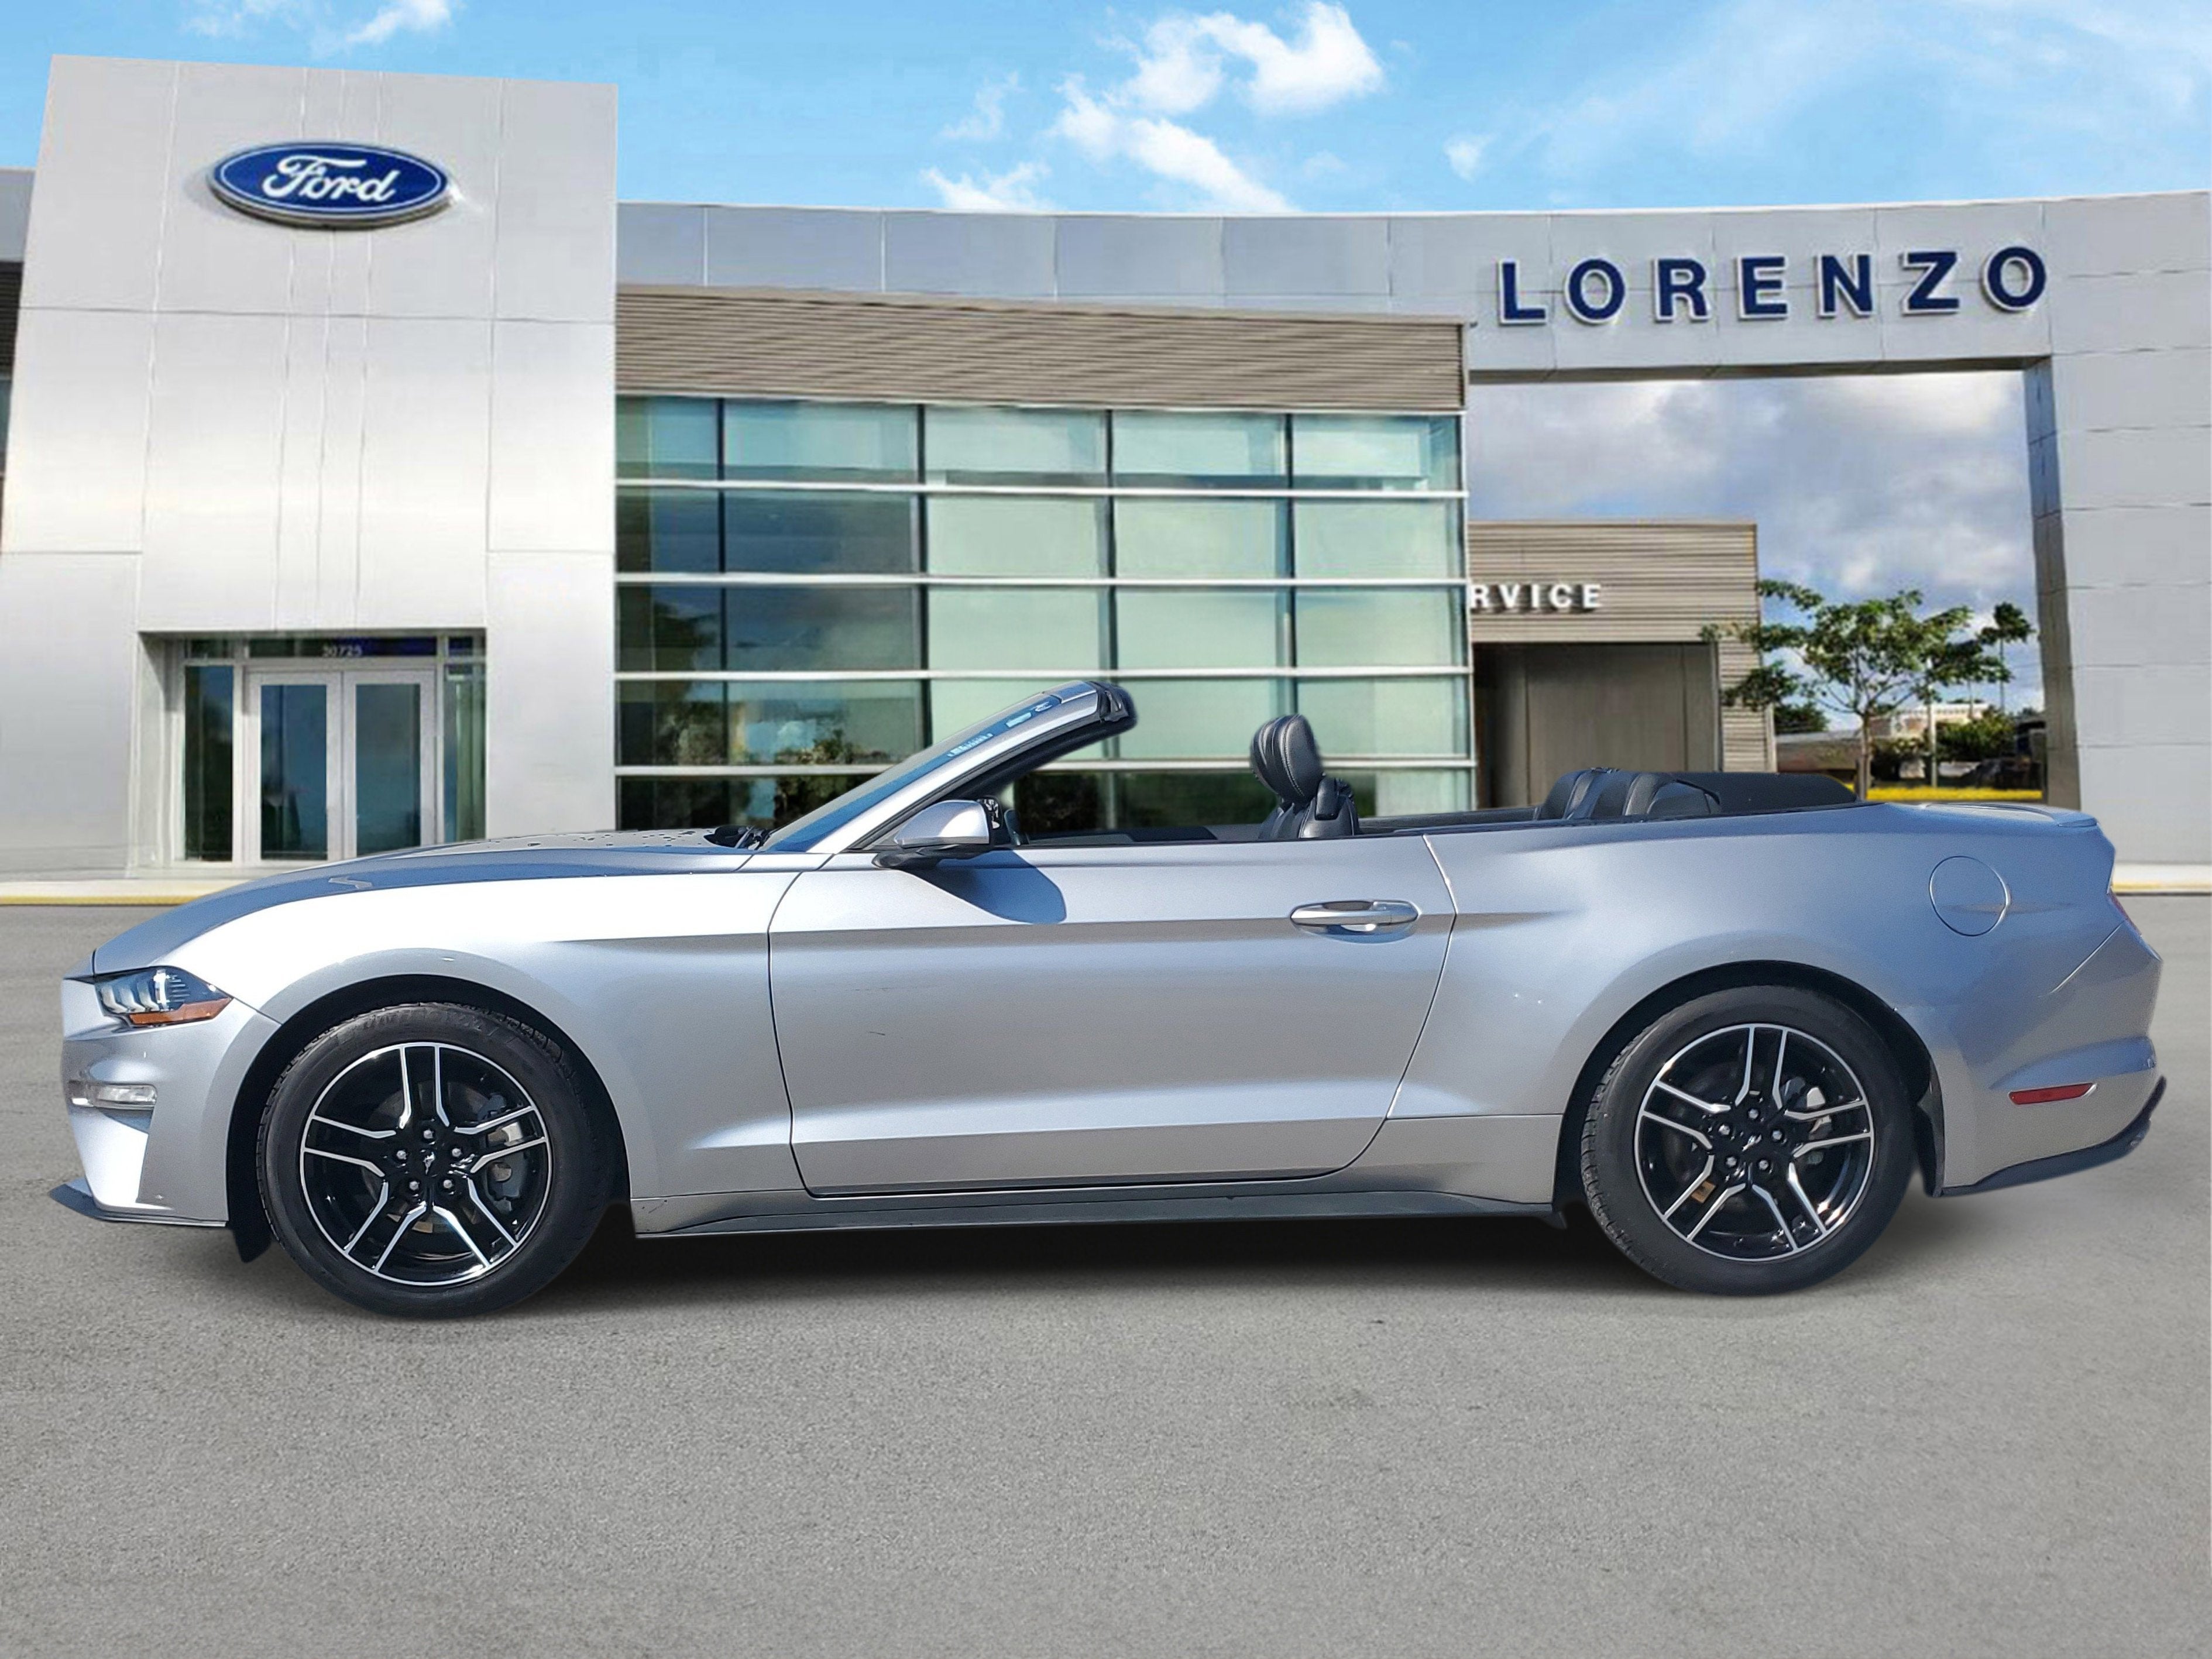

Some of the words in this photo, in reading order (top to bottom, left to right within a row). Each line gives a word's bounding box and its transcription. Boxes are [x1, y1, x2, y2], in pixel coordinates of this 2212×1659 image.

[263, 154, 400, 201] Ford
[1499, 246, 2046, 324] LORENZO
[1470, 584, 1602, 609] RVICE
